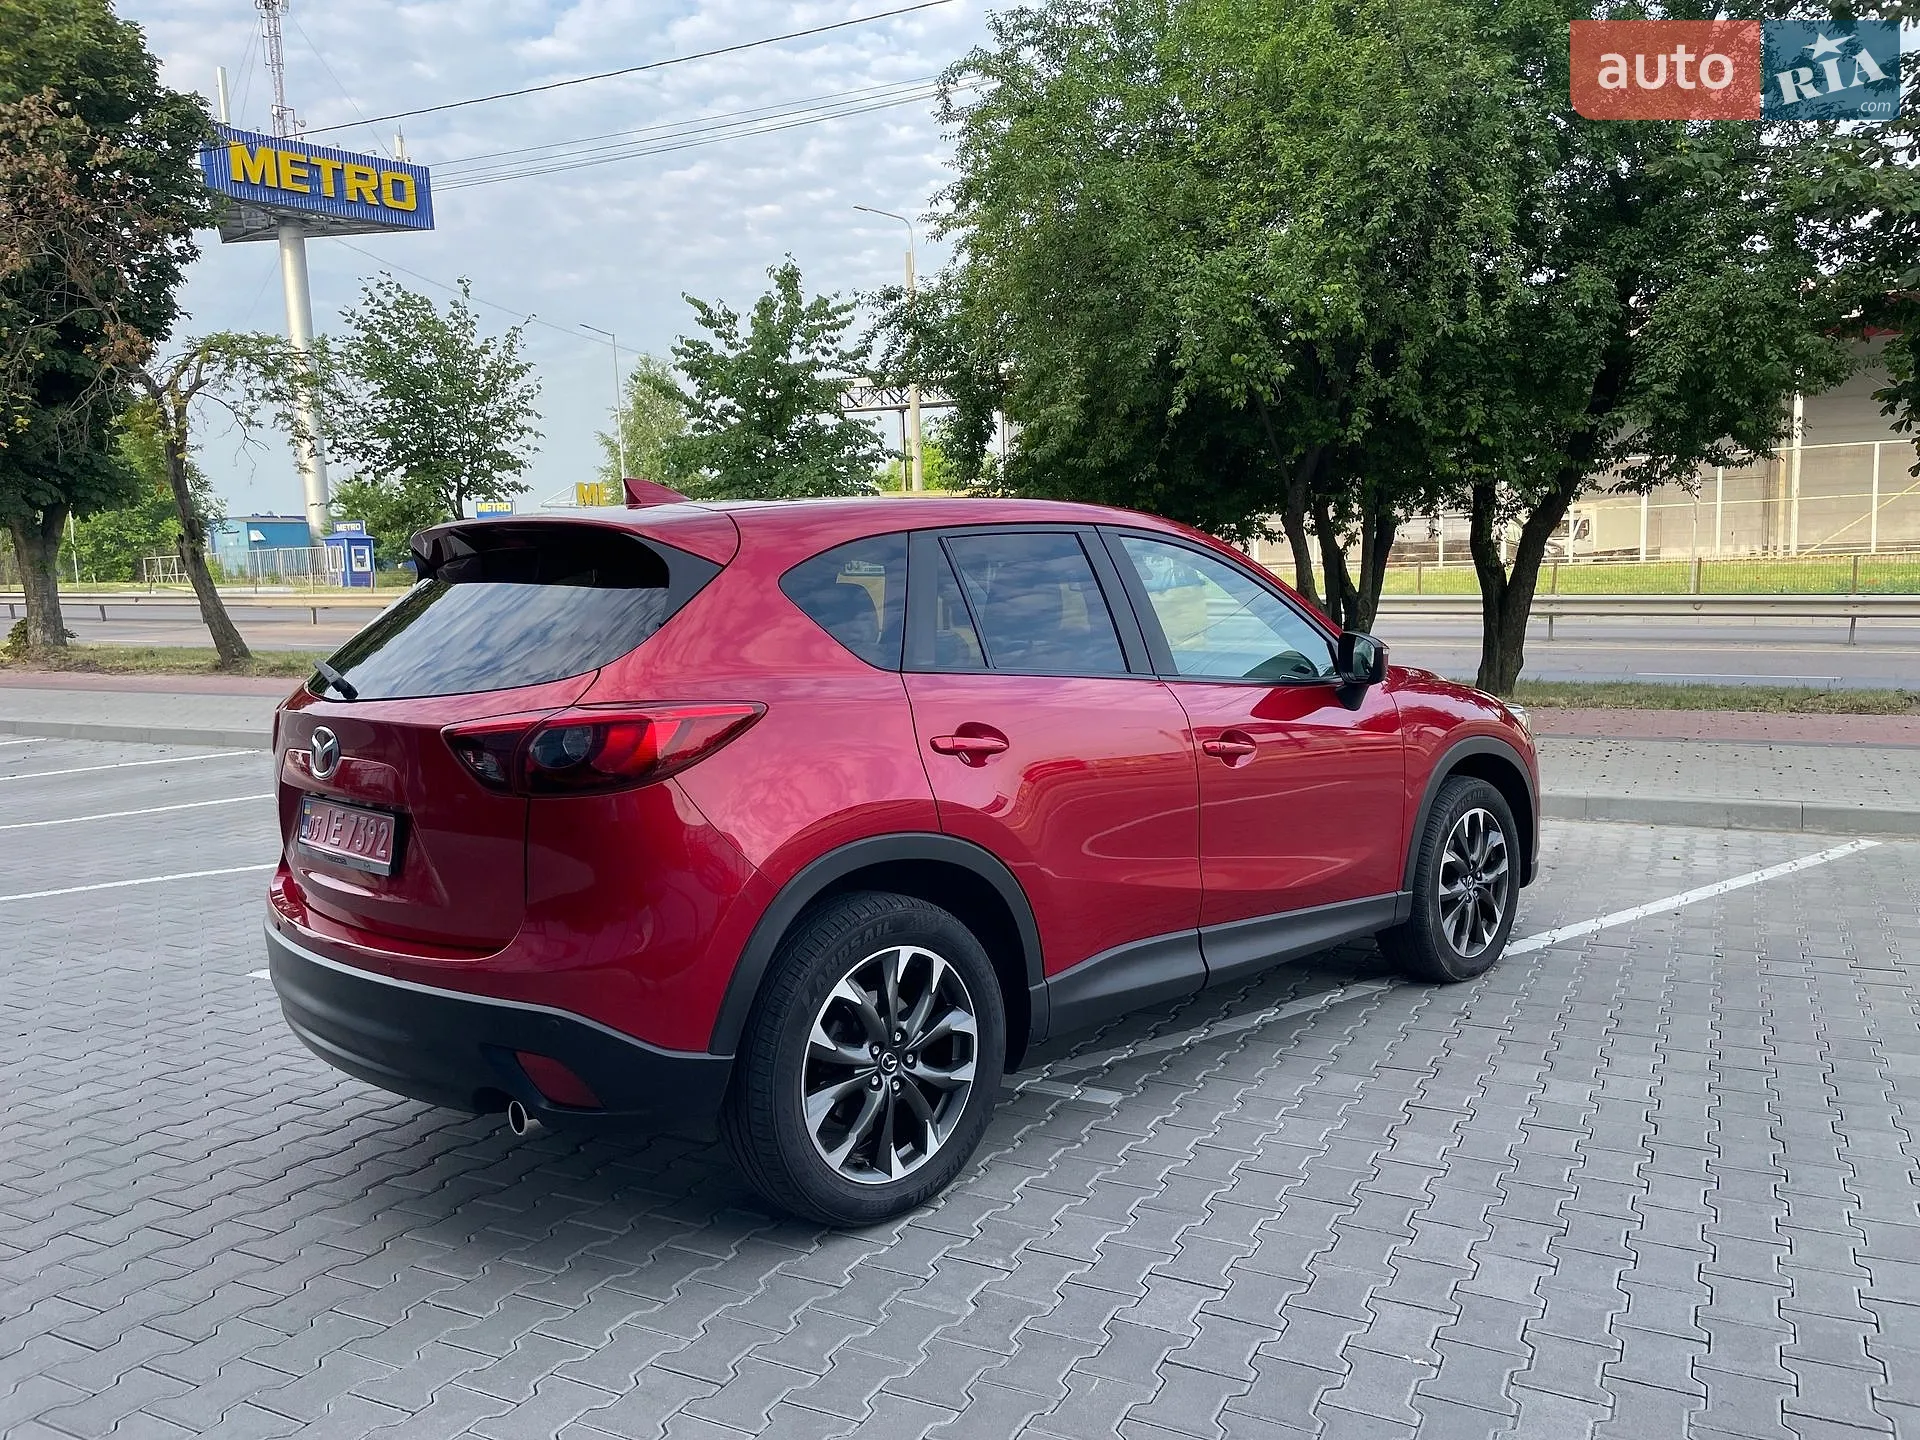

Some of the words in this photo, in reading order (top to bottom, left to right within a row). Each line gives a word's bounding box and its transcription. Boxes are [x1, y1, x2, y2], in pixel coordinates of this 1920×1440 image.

[229, 141, 418, 212] METRO
[477, 502, 512, 513] METRO
[336, 523, 361, 532] METRO
[346, 814, 389, 858] 7392
